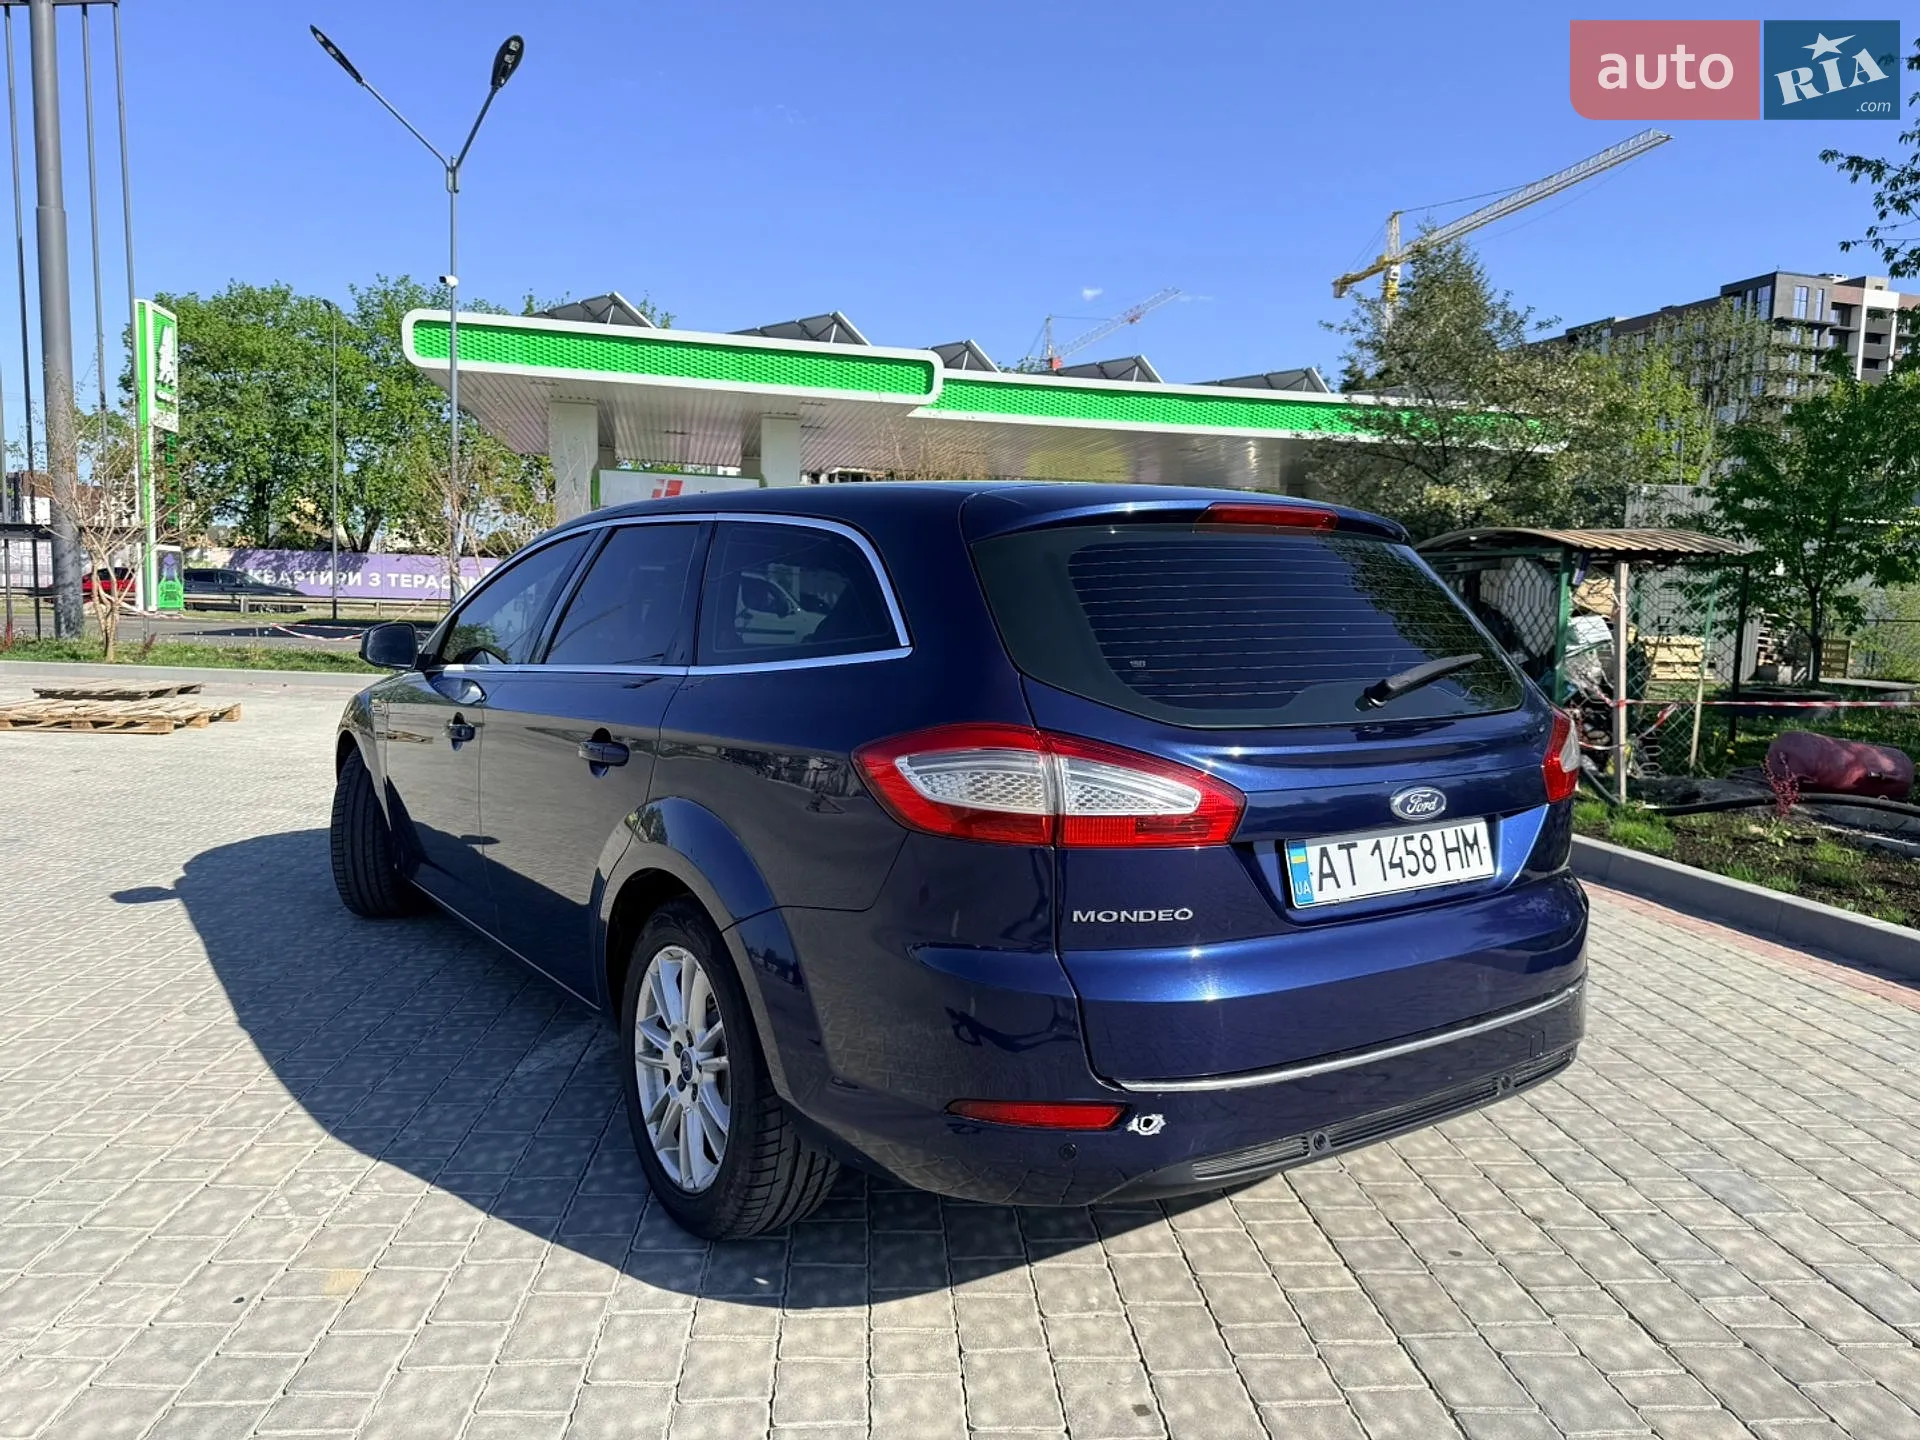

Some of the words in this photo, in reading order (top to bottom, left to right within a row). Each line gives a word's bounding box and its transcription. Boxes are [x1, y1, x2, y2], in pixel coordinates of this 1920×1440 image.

[248, 569, 362, 587] КВАРТИРИ
[1406, 793, 1437, 814] Ford
[1317, 842, 1359, 892] AT
[1370, 832, 1438, 882] 1458
[1441, 825, 1484, 872] HM
[1295, 881, 1312, 896] UA
[1072, 907, 1194, 923] MONDEO
